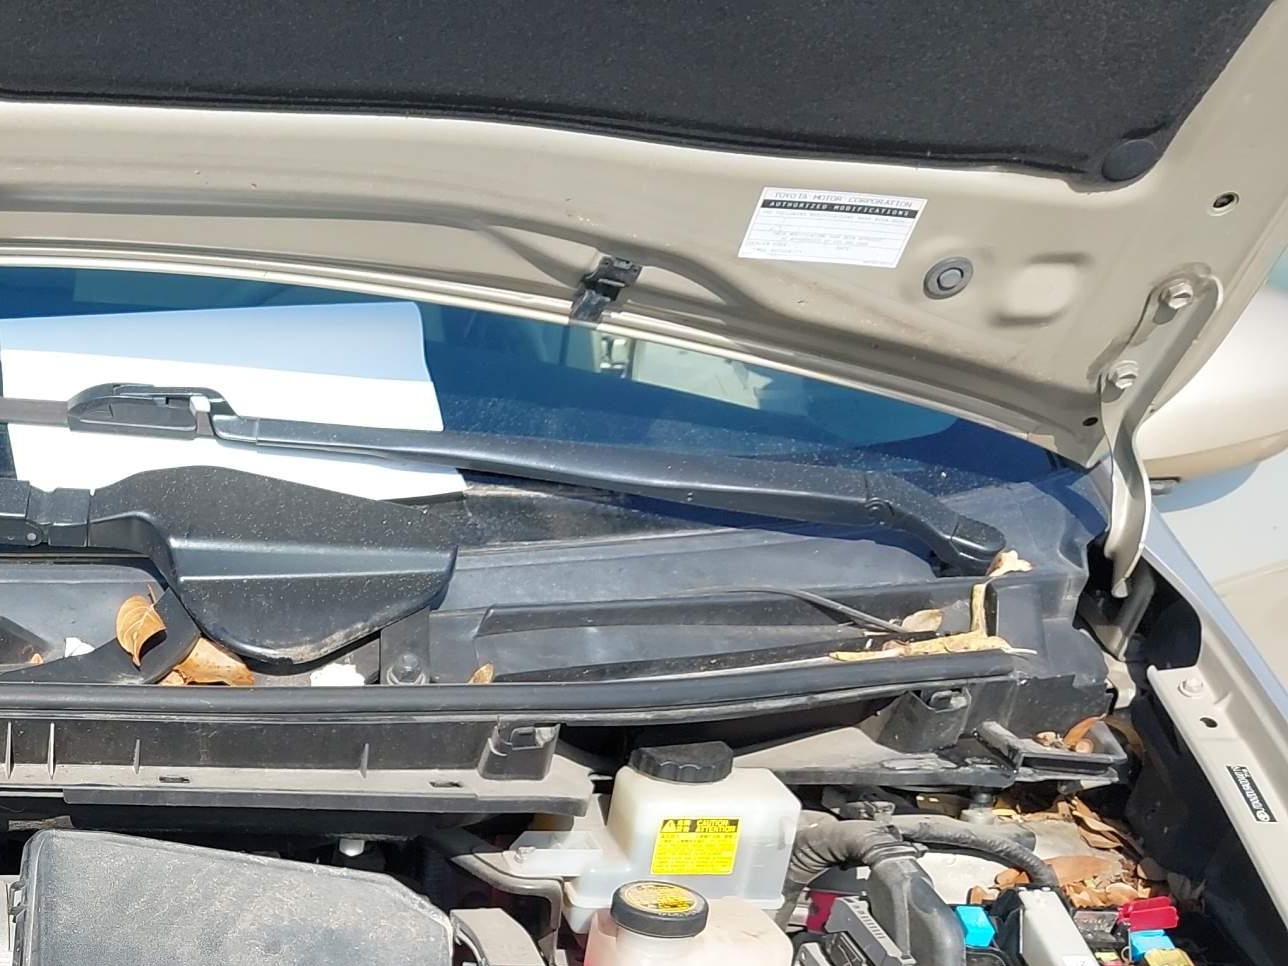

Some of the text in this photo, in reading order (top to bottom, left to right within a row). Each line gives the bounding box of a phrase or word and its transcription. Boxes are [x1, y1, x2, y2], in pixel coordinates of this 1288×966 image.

[775, 192, 913, 208] TOYOTA MOTOR CORPORATION
[769, 201, 829, 211] AUTHORIZED
[833, 204, 910, 217] MODIFICATIONS
